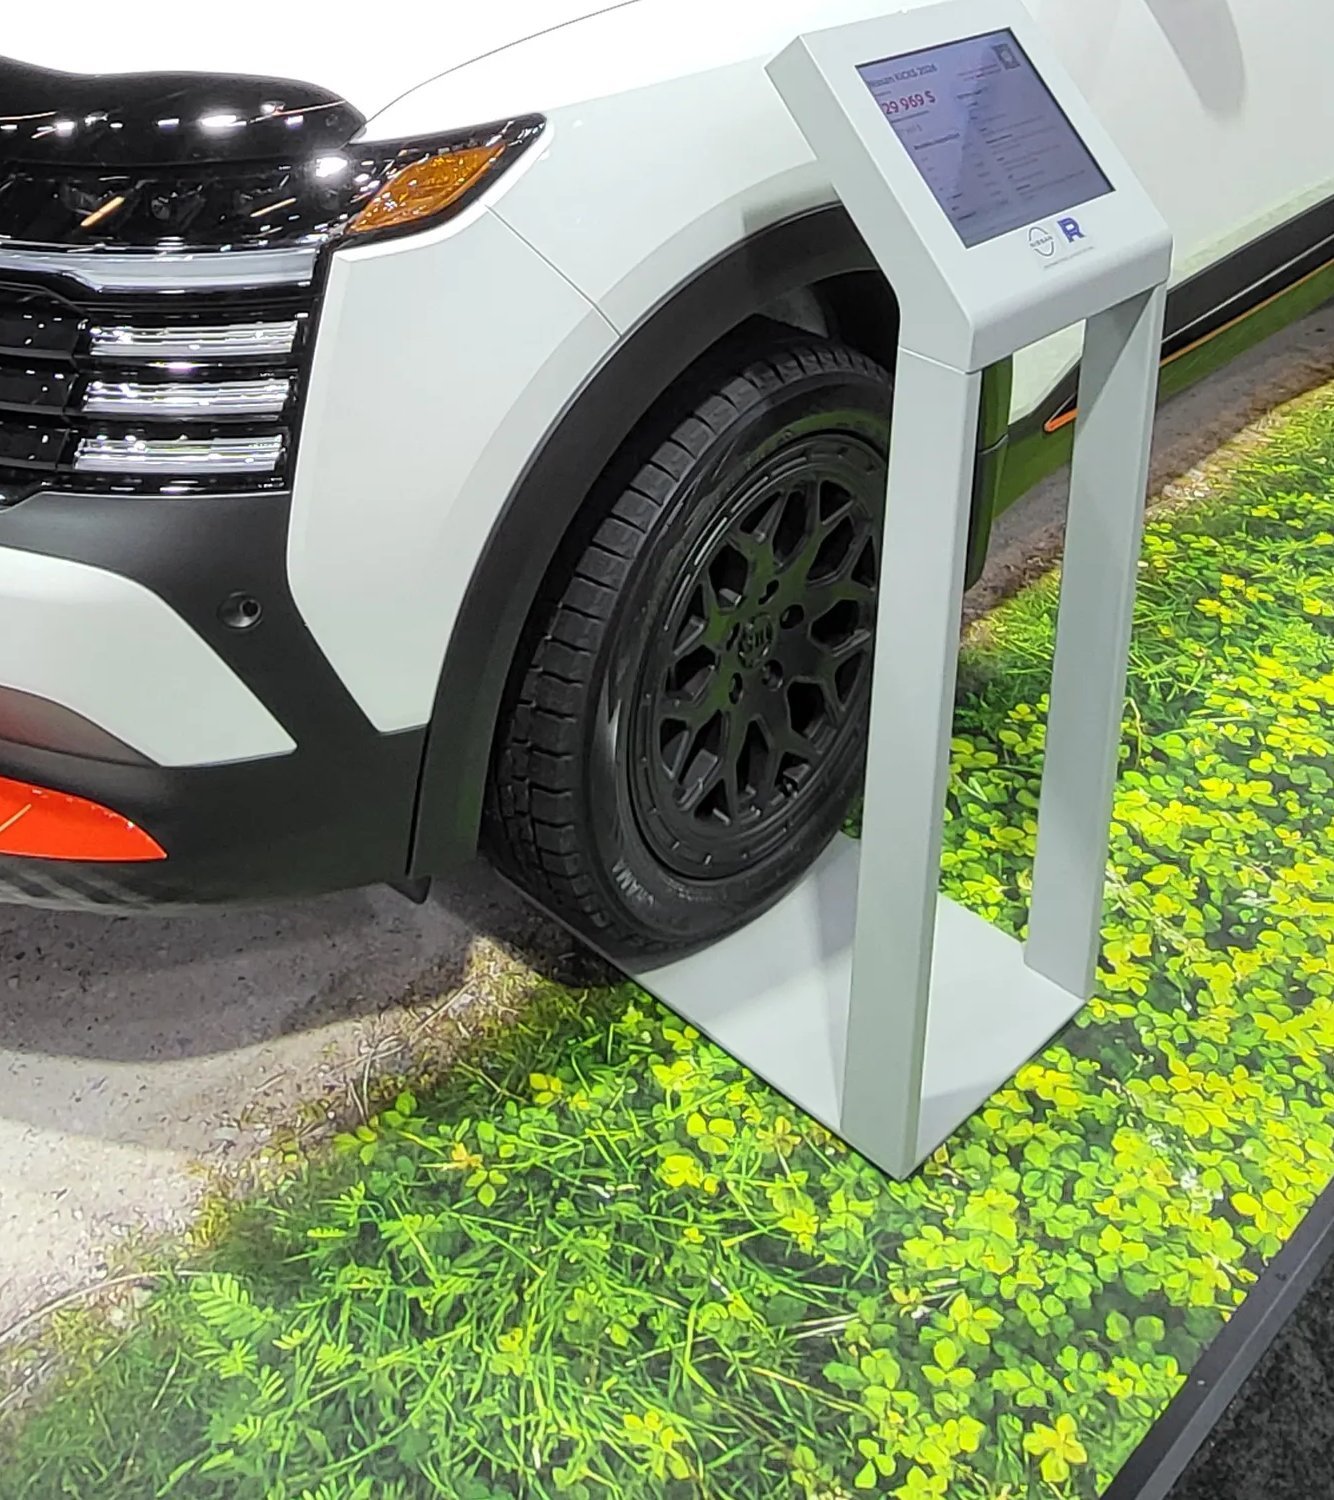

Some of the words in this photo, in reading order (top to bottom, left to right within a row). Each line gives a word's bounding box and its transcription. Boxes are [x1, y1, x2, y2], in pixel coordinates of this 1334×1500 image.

[893, 68, 918, 82] KICKS
[881, 100, 899, 115] 29
[899, 93, 925, 111] 969
